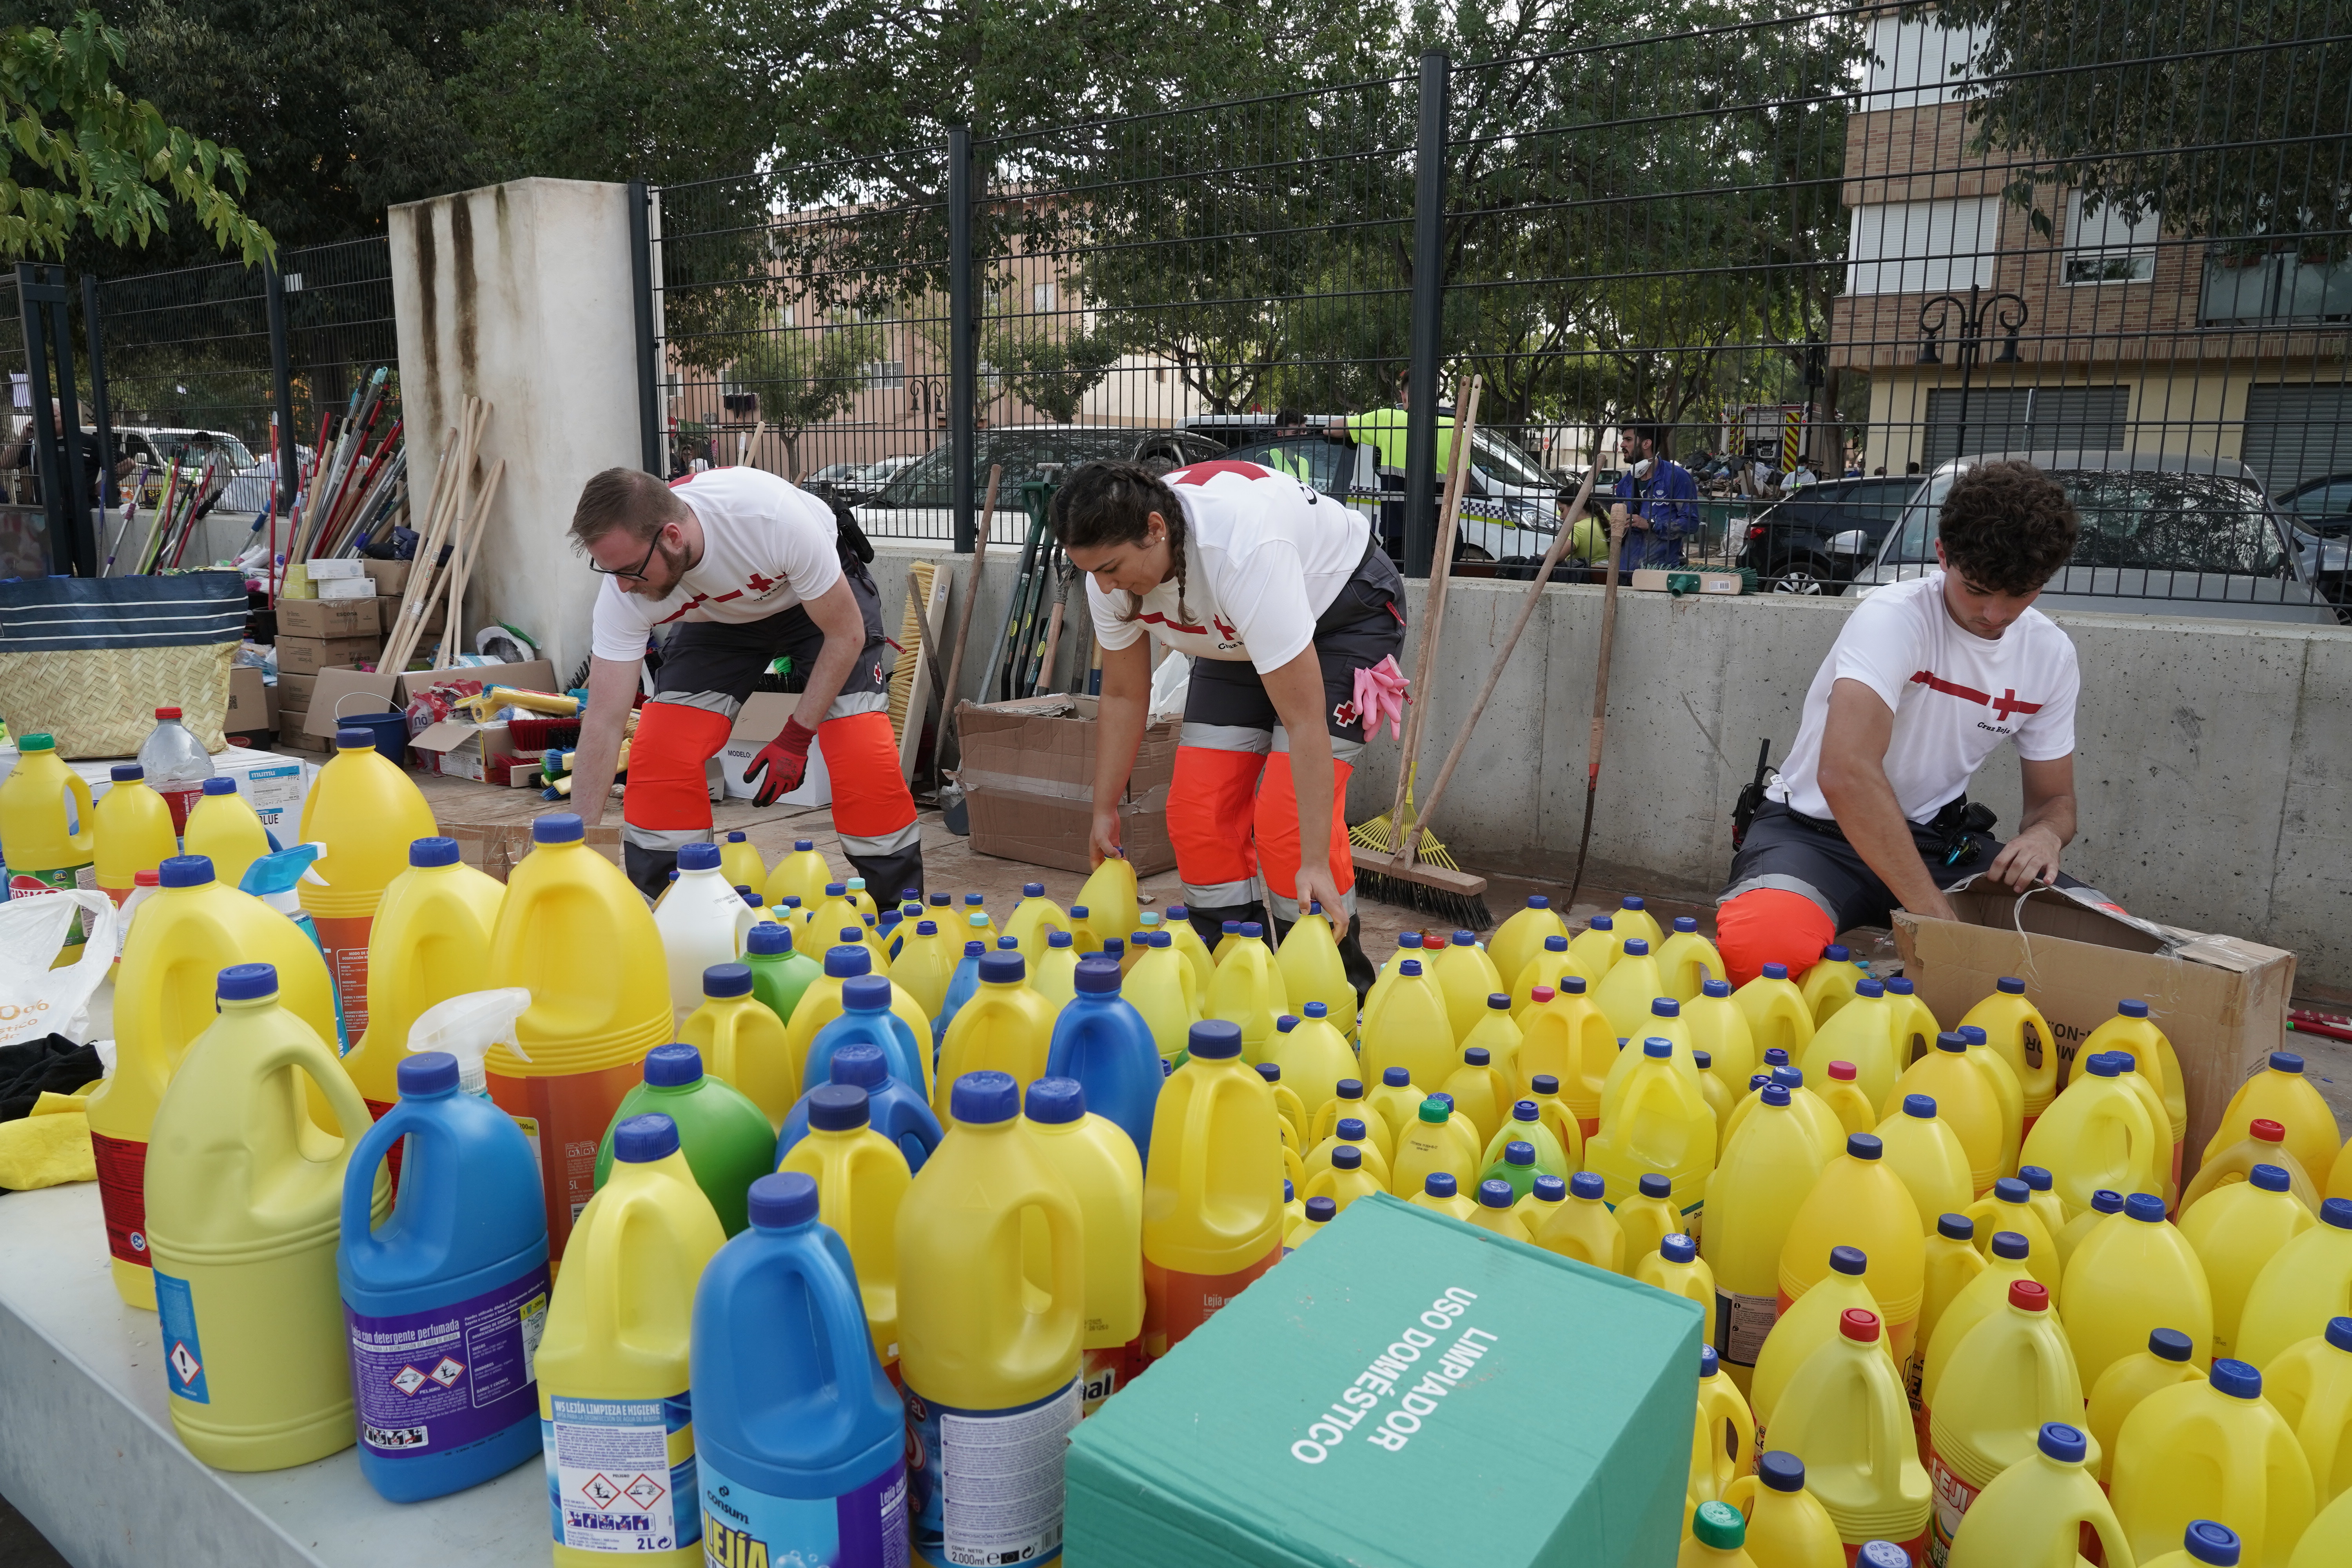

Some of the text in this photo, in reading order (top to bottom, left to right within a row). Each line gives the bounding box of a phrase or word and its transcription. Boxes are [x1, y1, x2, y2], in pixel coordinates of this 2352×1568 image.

[1977, 722, 1996, 731] Cruz
[259, 814, 278, 825] BLUE
[570, 1180, 578, 1189] 5L
[1204, 1294, 1221, 1307] Lejía
[497, 1316, 511, 1325] EMPLEO
[362, 1332, 372, 1343] con
[374, 1331, 415, 1345] detergente
[418, 1319, 459, 1341] perfumada
[389, 1342, 416, 1352] DESINFECCIÓN
[443, 1333, 458, 1342] BEBIDA
[474, 1361, 494, 1372] INODOROS
[493, 1377, 508, 1387] COCINAS
[1290, 1287, 1478, 1464] USO DOMÉSTICO
[419, 1386, 441, 1394] PELIGRO
[1367, 1327, 1498, 1451] LIMPIADOR
[555, 1401, 661, 1416] W5 LEJÍA LIMPIEZA E HIGIENE
[911, 1400, 924, 1418] 2L
[880, 1485, 895, 1507] Lejía
[708, 1490, 750, 1524] consum
[637, 1538, 655, 1549] 2 L
[704, 1508, 769, 1568] LEJÍA
[952, 1552, 984, 1565] 2.000ml
